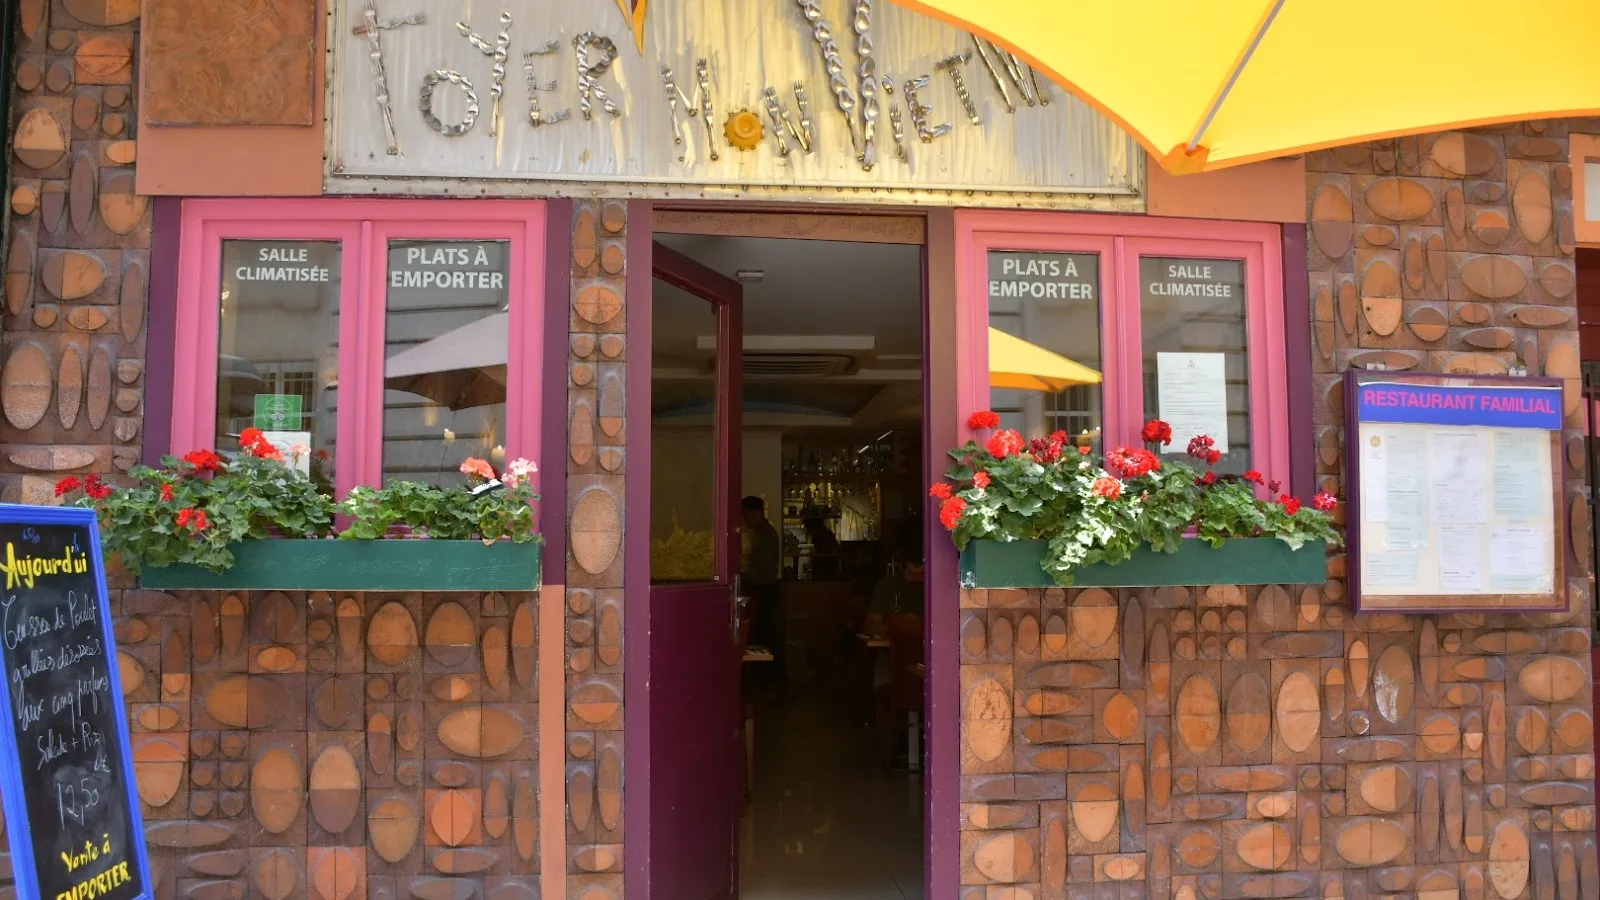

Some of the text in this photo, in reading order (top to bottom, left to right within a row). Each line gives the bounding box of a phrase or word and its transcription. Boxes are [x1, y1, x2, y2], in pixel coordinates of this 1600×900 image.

[258, 247, 308, 263] SALLE
[407, 246, 489, 266] PLATS À
[236, 266, 329, 283] CLIMATISÉE
[1003, 258, 1078, 277] PLATS À
[1168, 265, 1211, 279] SALLE
[391, 271, 504, 290] EMPORTER
[989, 280, 1093, 300] EMPORTER
[1149, 282, 1232, 298] CLIMATISÉE
[1363, 389, 1556, 414] RESTAURANT FAMILIAL
[61, 839, 100, 873] Vente
